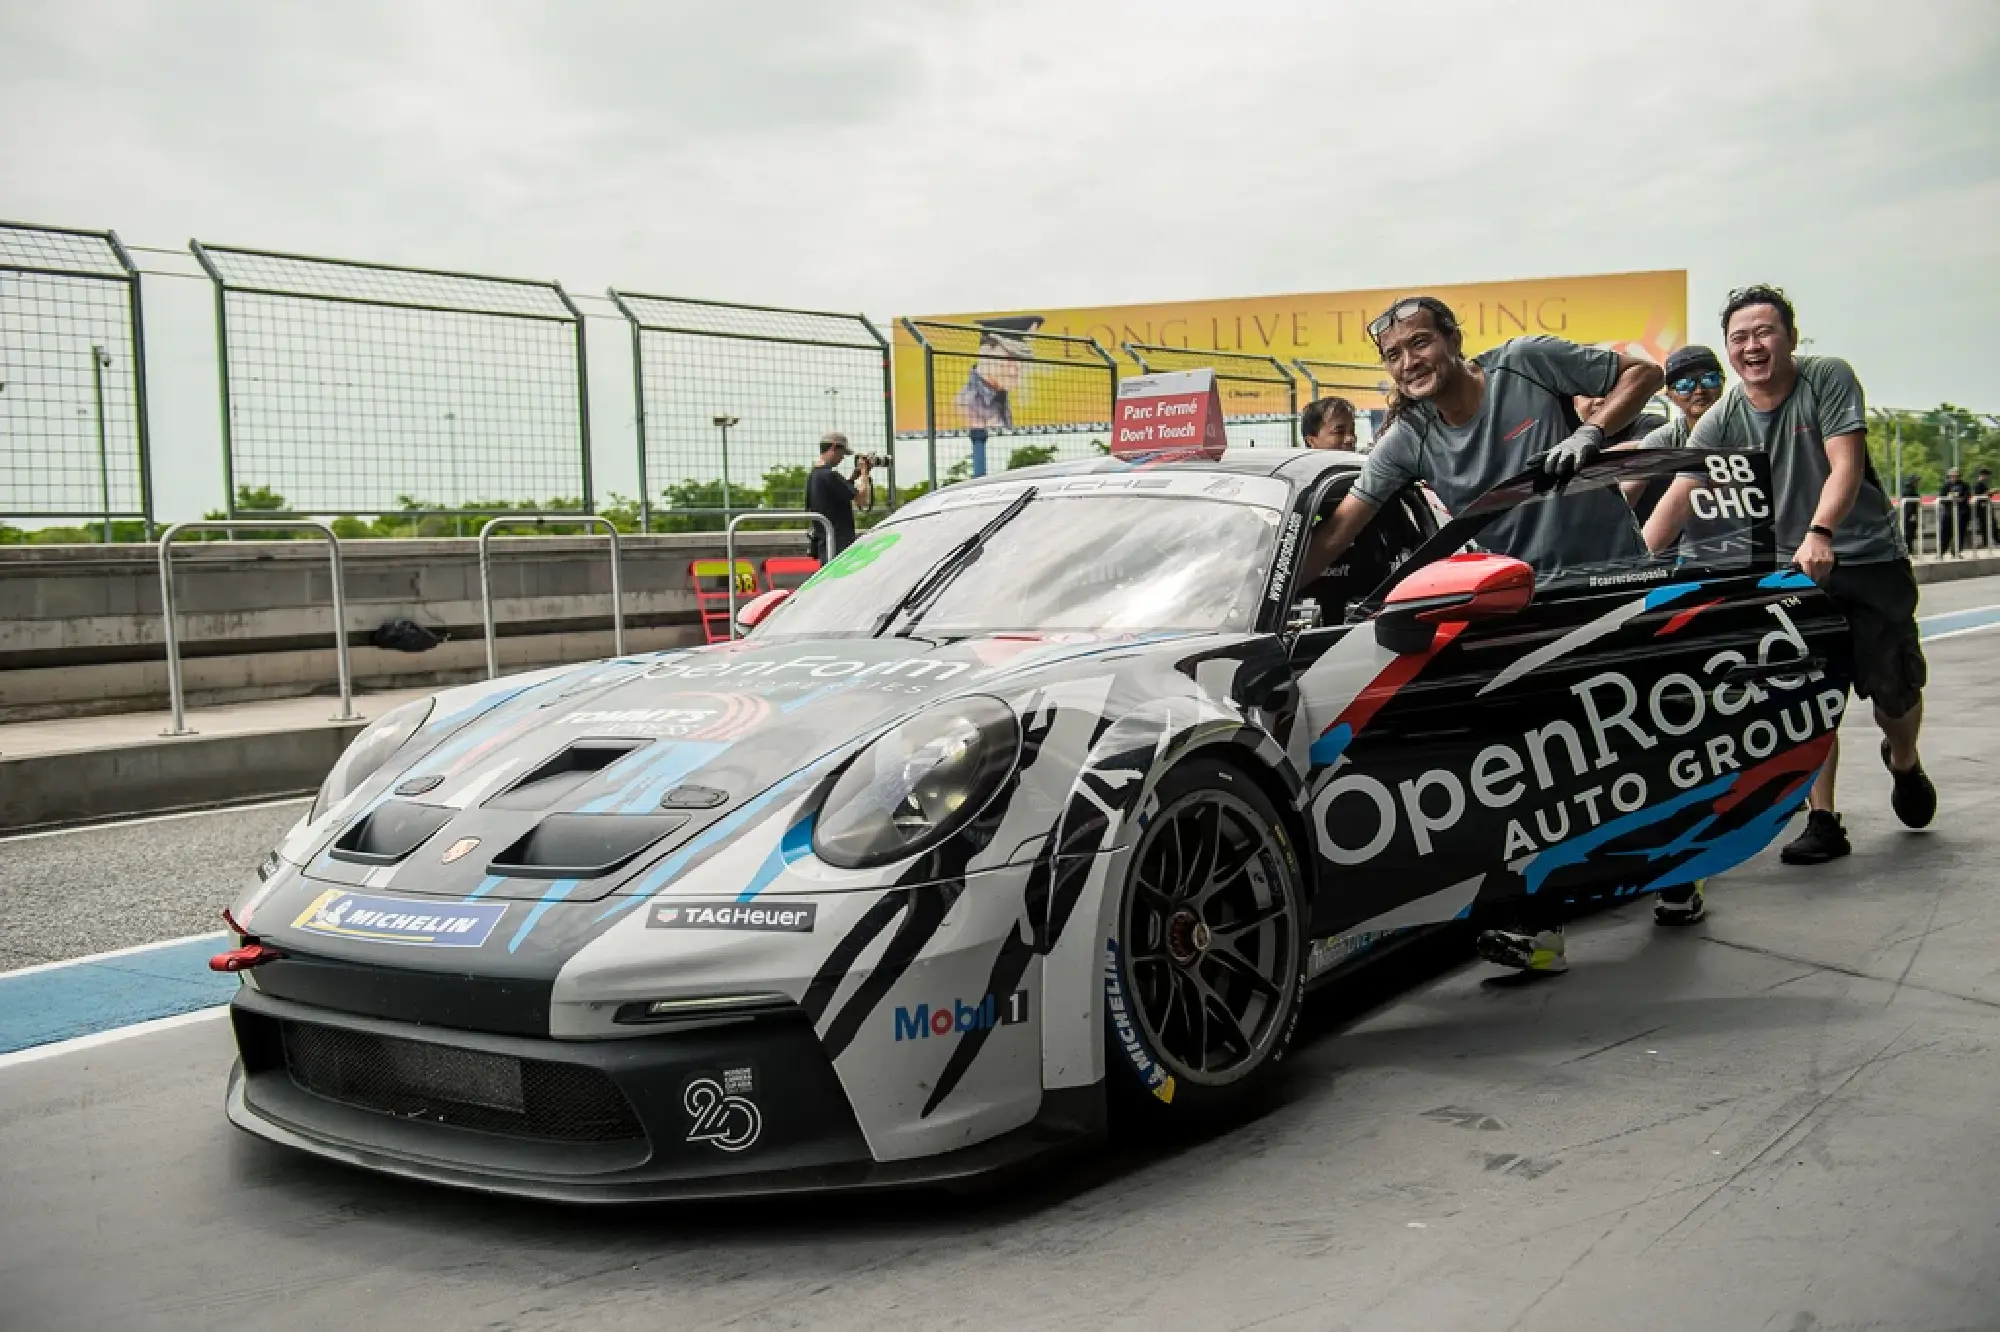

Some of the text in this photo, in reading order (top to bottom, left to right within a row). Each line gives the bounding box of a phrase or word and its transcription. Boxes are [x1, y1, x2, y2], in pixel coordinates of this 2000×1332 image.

[1062, 318, 1190, 359] LONG
[1212, 311, 1309, 351] LIVE
[1457, 296, 1568, 338] ING
[1123, 397, 1198, 421] Parc Fermé
[1120, 425, 1154, 442] Don't
[1157, 421, 1196, 440] Touch
[1704, 454, 1756, 483] 88
[1689, 486, 1769, 520] CHC
[1312, 603, 1827, 865] OpenRoad
[1503, 689, 1846, 861] AUTO GROUP
[345, 909, 480, 933] MICHELIN
[895, 993, 995, 1042] Mobil
[1104, 950, 1152, 1072] MICHELIN
